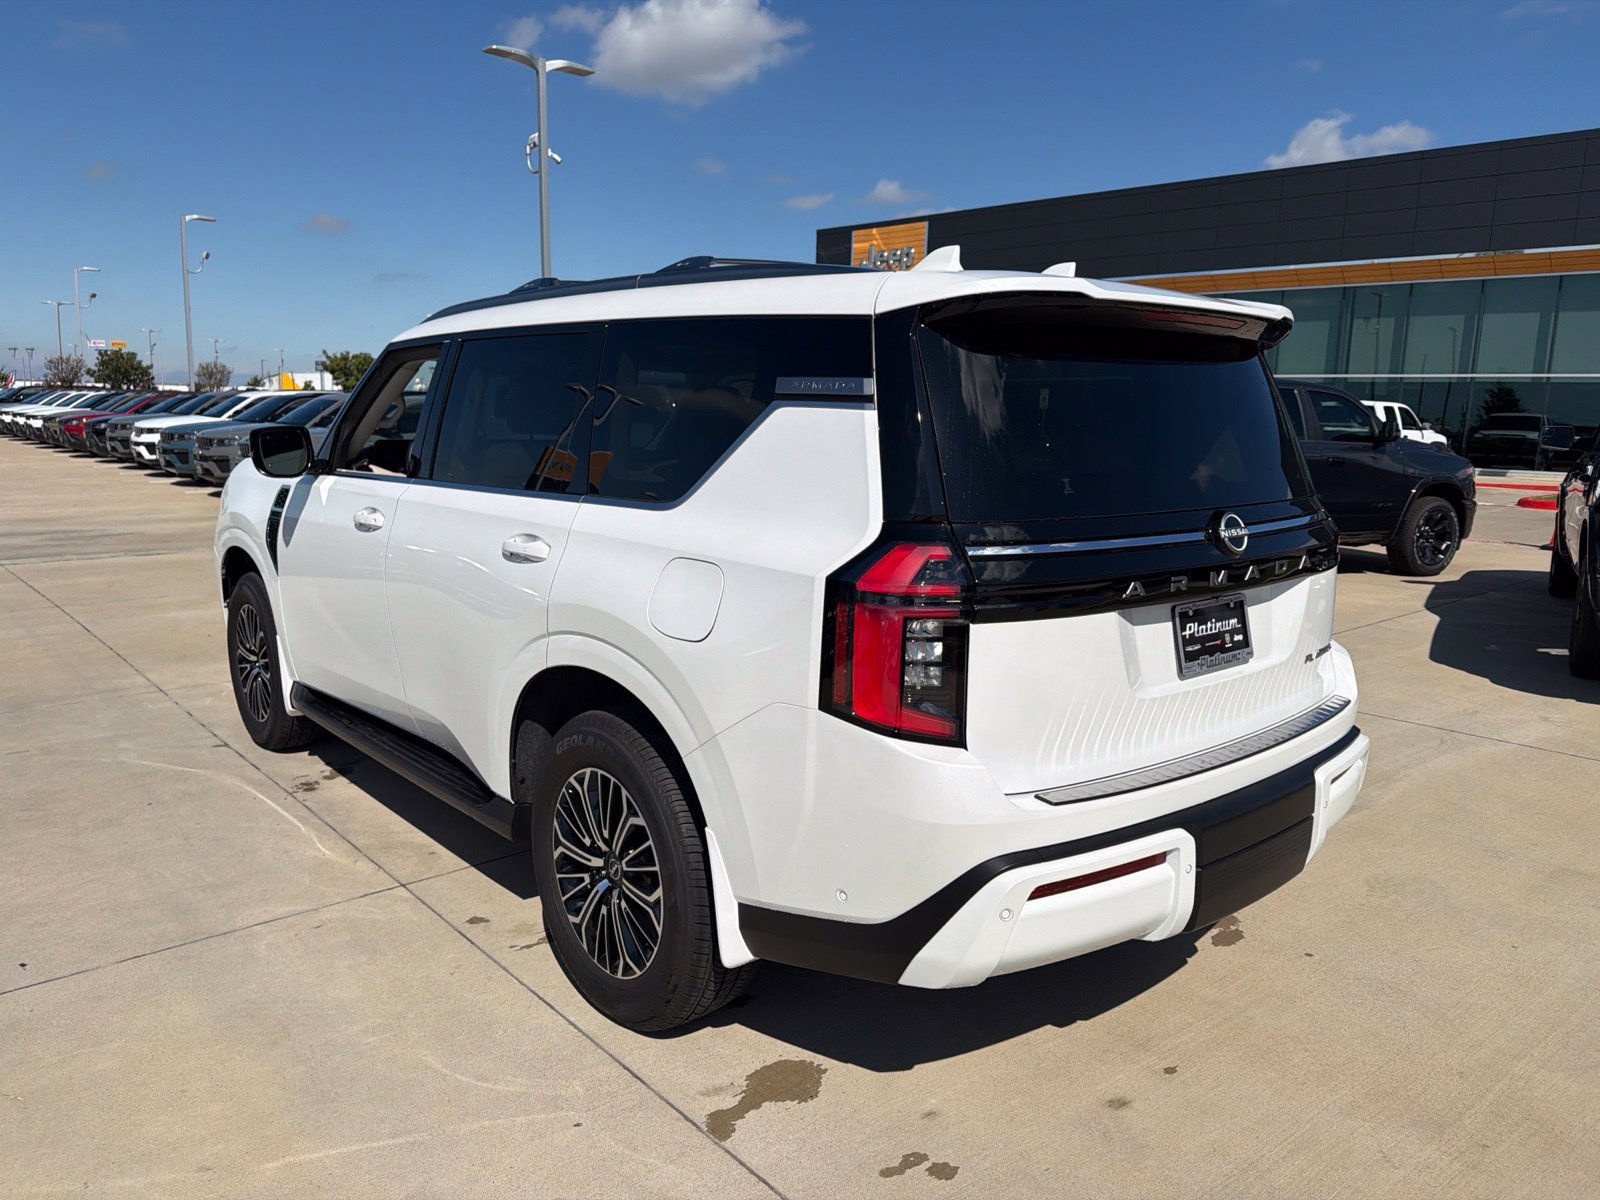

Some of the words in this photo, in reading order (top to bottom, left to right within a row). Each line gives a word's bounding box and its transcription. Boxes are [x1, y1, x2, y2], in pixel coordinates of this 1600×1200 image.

[859, 242, 915, 271] Jeep
[1220, 528, 1250, 538] NISSAN
[1122, 555, 1312, 599] ARMADA
[1182, 618, 1241, 639] Platinum
[1200, 652, 1240, 668] Platinum
